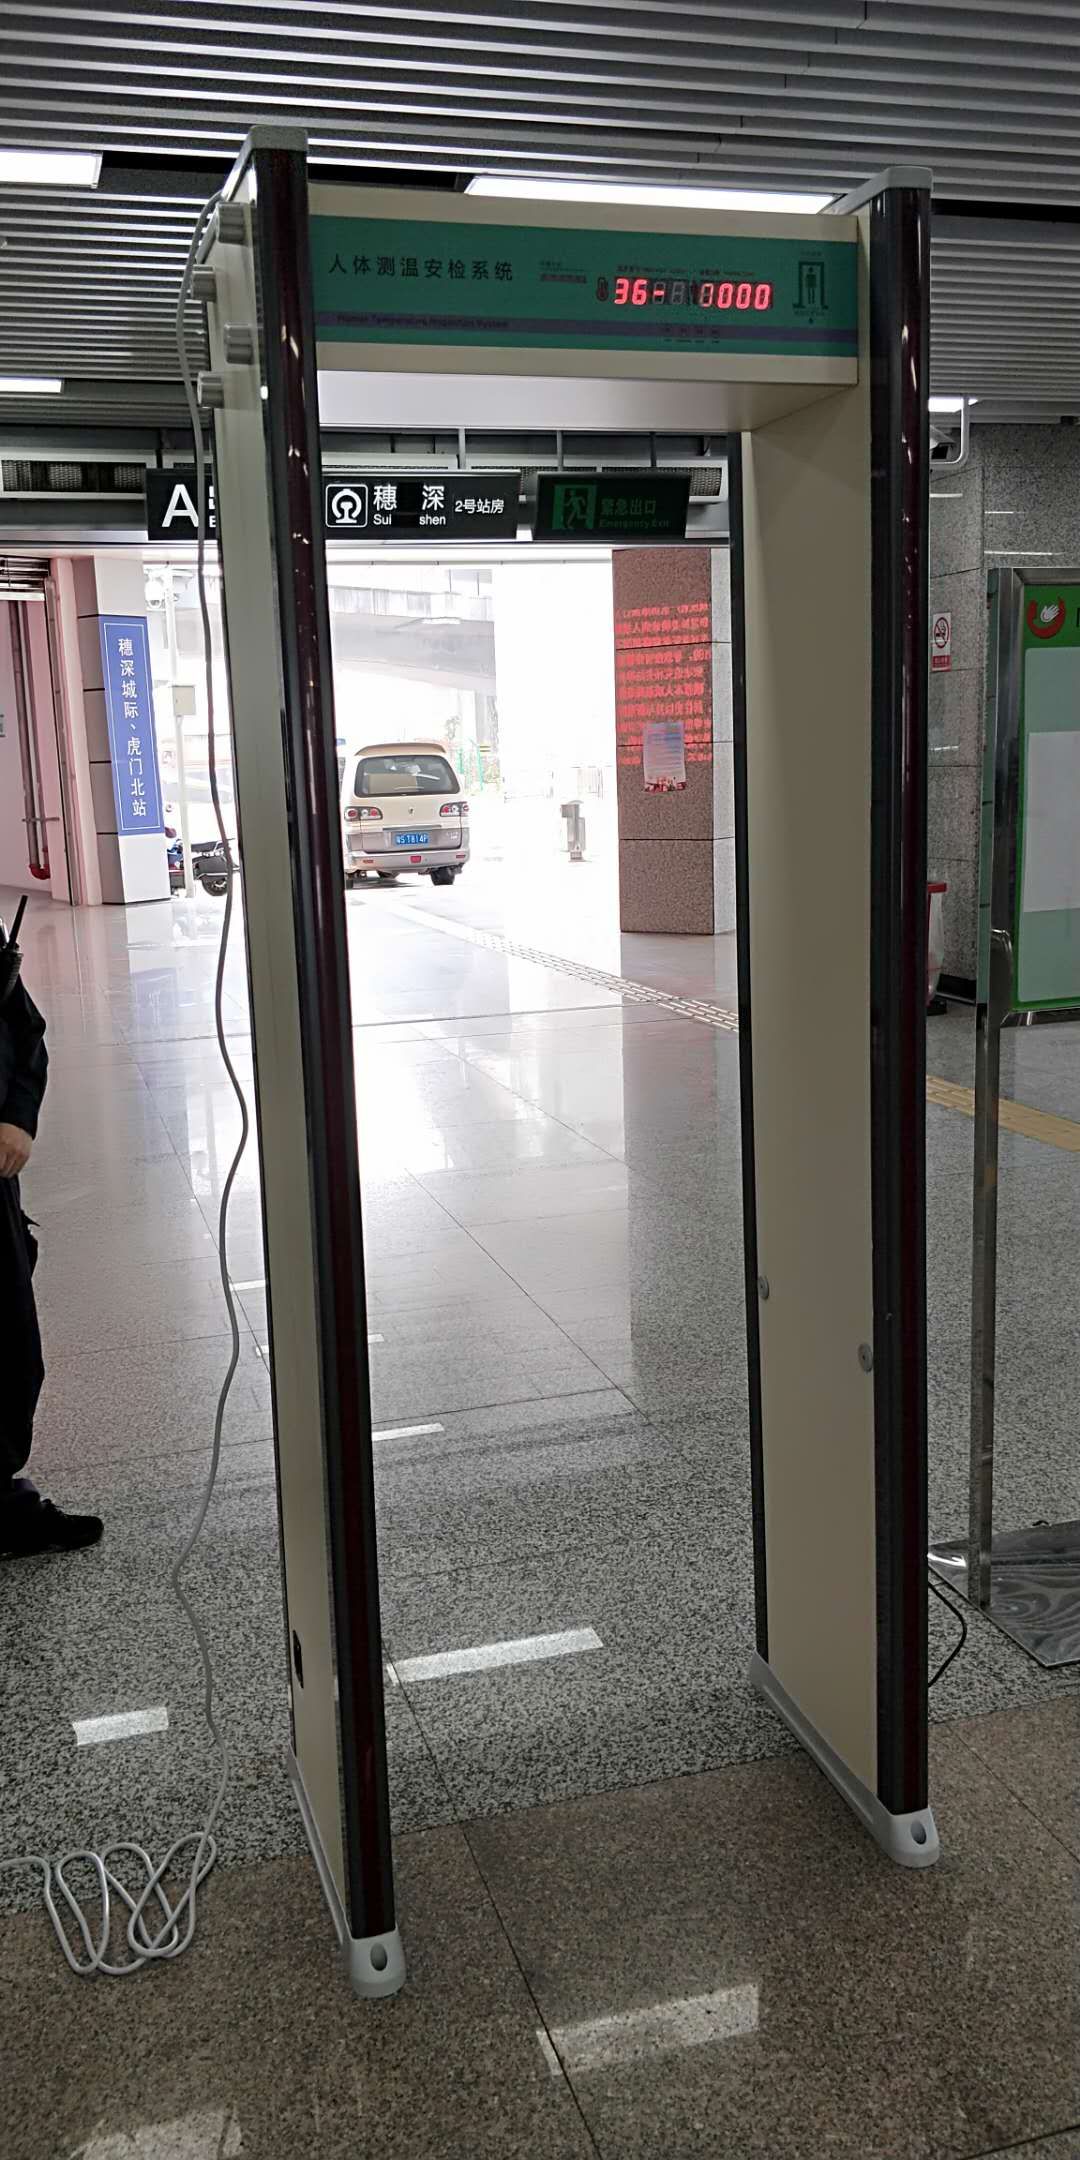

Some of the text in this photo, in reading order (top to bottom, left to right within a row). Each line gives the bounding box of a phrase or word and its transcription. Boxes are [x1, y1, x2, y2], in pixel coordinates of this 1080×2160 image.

[328, 252, 513, 281] 人体测温安检系统
[161, 483, 199, 528] A
[373, 484, 446, 512] 穗 深
[454, 498, 505, 514] 2号站房
[373, 513, 447, 526] Sui shen
